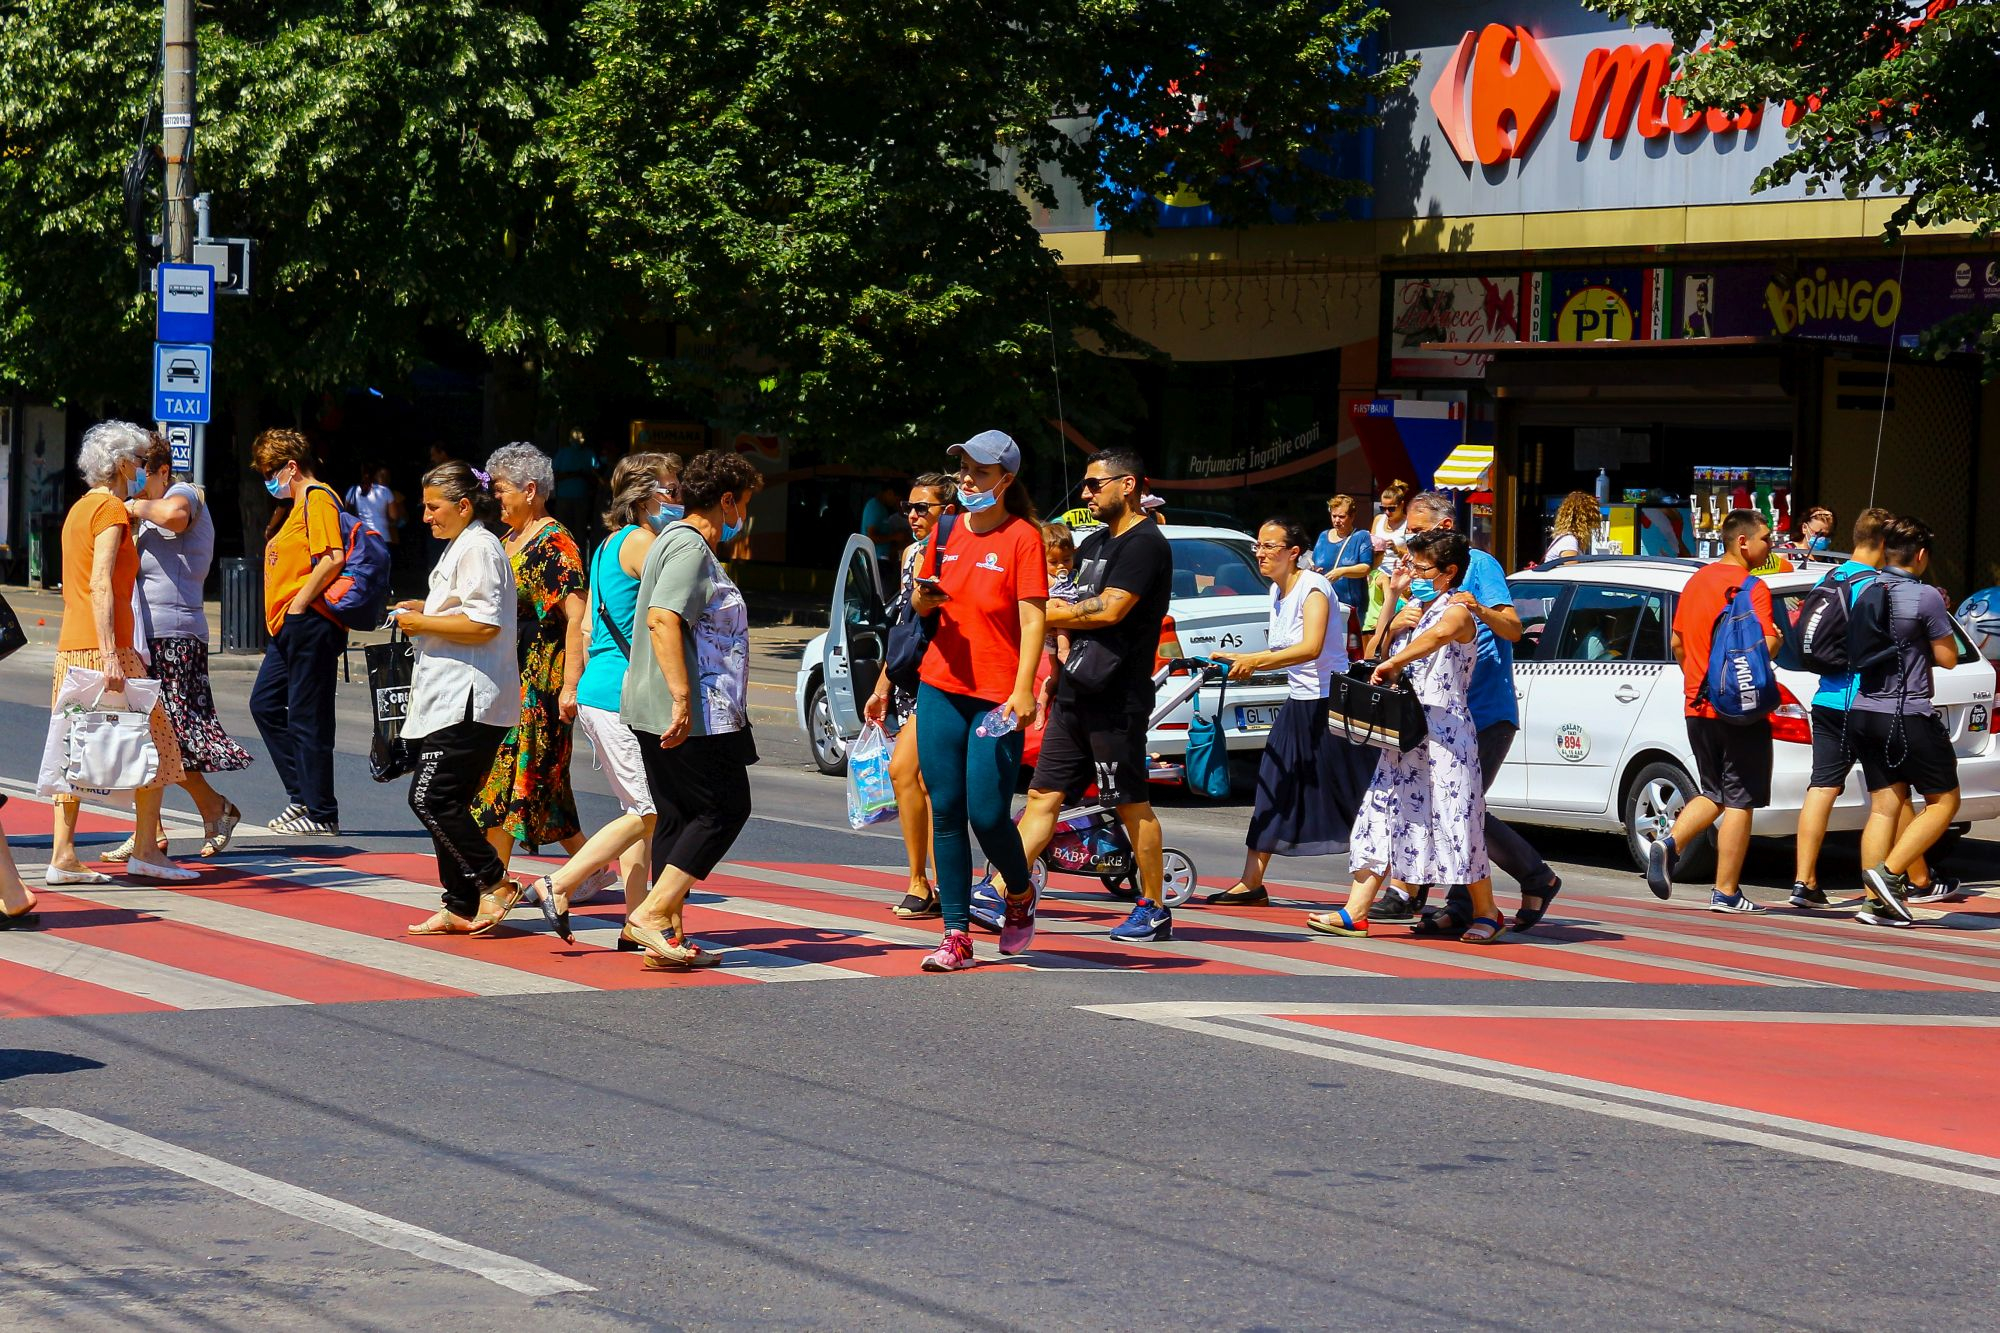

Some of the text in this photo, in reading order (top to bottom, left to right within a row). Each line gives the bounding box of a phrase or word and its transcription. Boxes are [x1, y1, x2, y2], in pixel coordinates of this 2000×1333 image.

[164, 398, 201, 415] TAXI
[171, 446, 191, 459] AXI
[1190, 453, 1246, 477] Parfumerie
[1294, 420, 1320, 450] copii
[1733, 655, 1757, 691] PUMA
[1247, 708, 1265, 724] GL
[1972, 713, 1986, 724] 167
[1564, 736, 1581, 749] 894
[1053, 847, 1123, 867] BABY CARE
